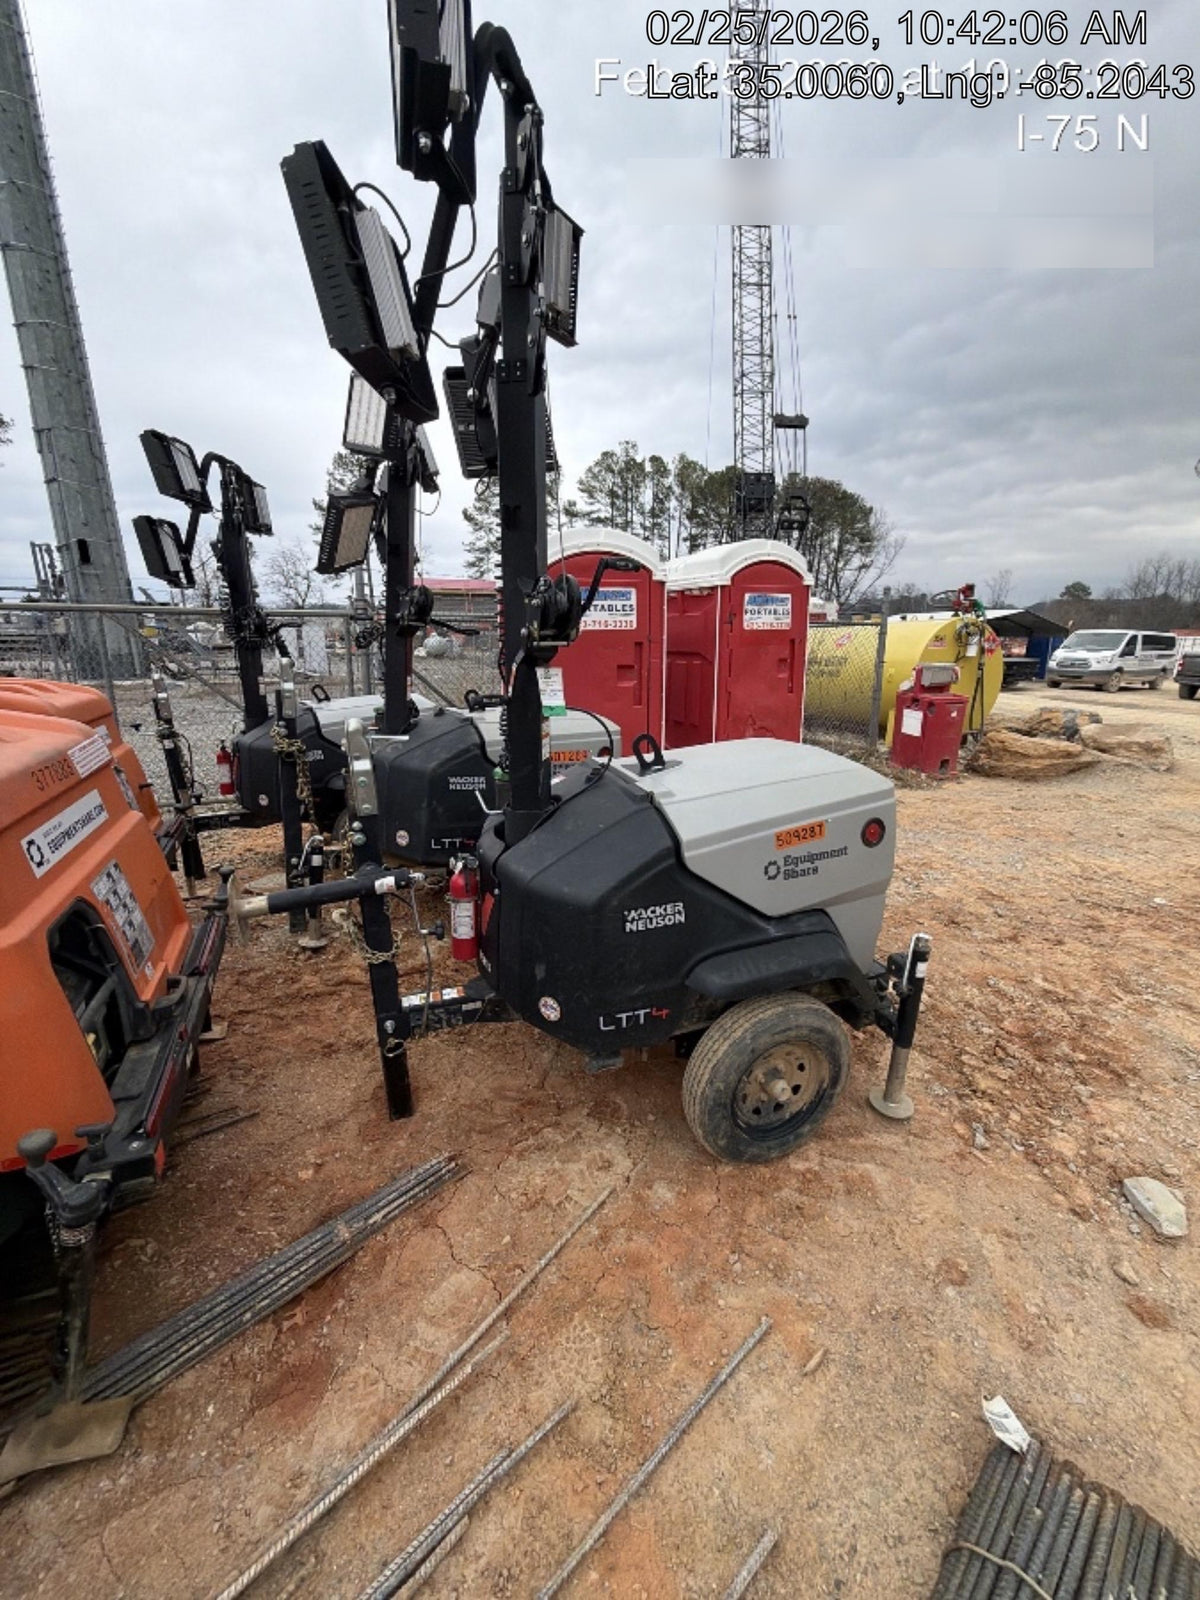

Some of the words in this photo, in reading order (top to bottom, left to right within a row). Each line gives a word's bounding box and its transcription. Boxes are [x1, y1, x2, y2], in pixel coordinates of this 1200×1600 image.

[783, 845, 849, 868] Equipment
[783, 865, 819, 881] Share
[623, 902, 684, 922] WACKER
[625, 912, 686, 932] NEUSON
